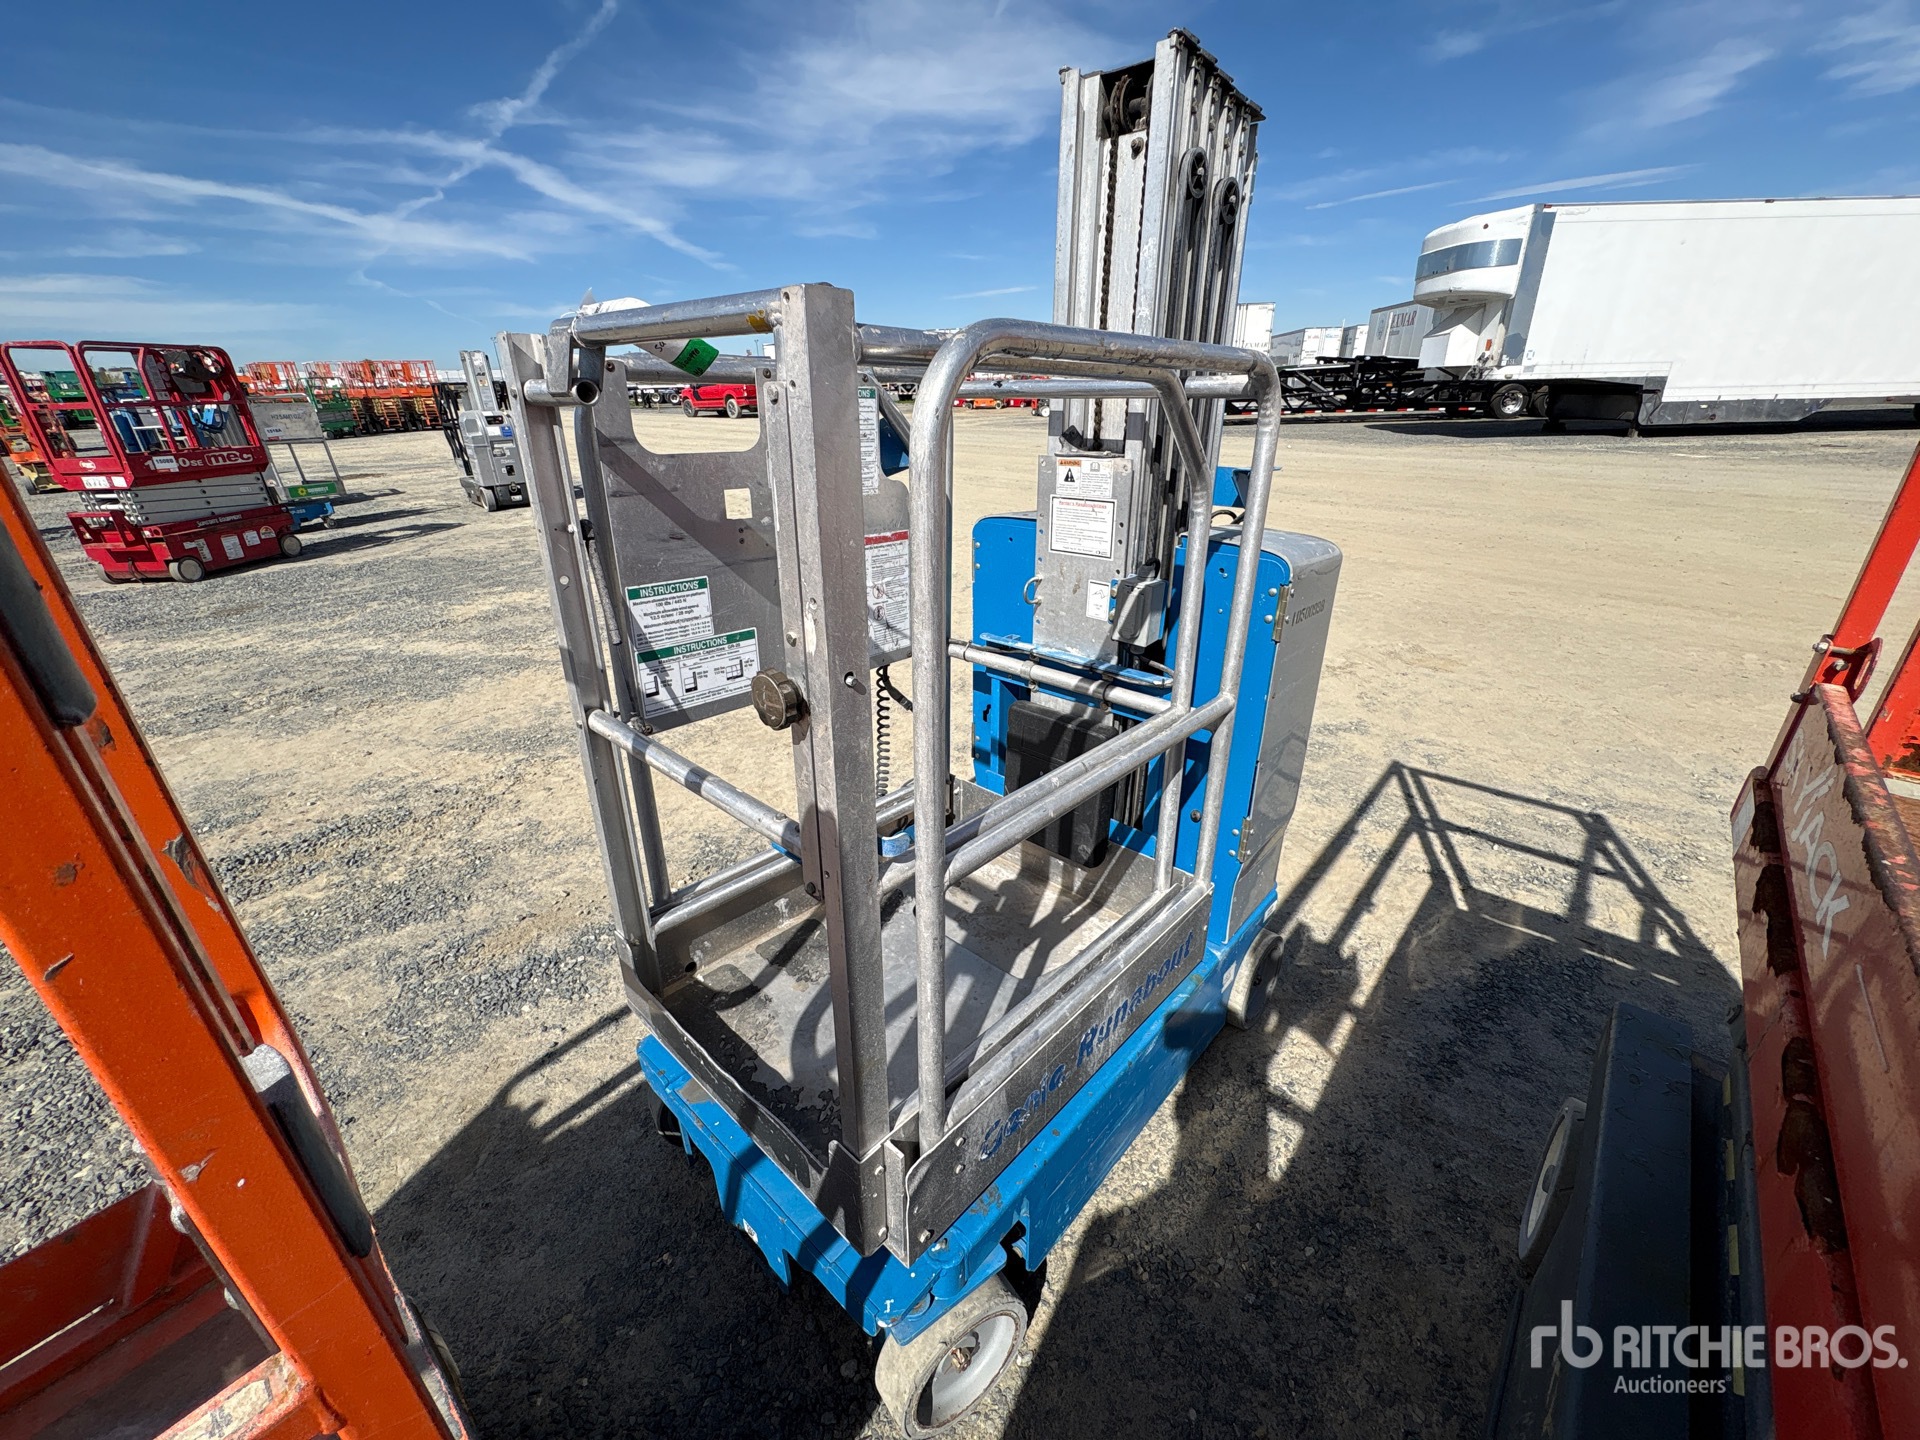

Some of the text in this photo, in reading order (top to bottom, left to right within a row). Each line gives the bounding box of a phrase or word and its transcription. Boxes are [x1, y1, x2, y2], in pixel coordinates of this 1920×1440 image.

[1389, 311, 1417, 328] EXMAR
[205, 451, 254, 466] mec
[640, 581, 699, 597] INSTRUCTIONS
[674, 637, 727, 655] INSTRUCTIONS
[979, 930, 1194, 1160] Genie Runabout
